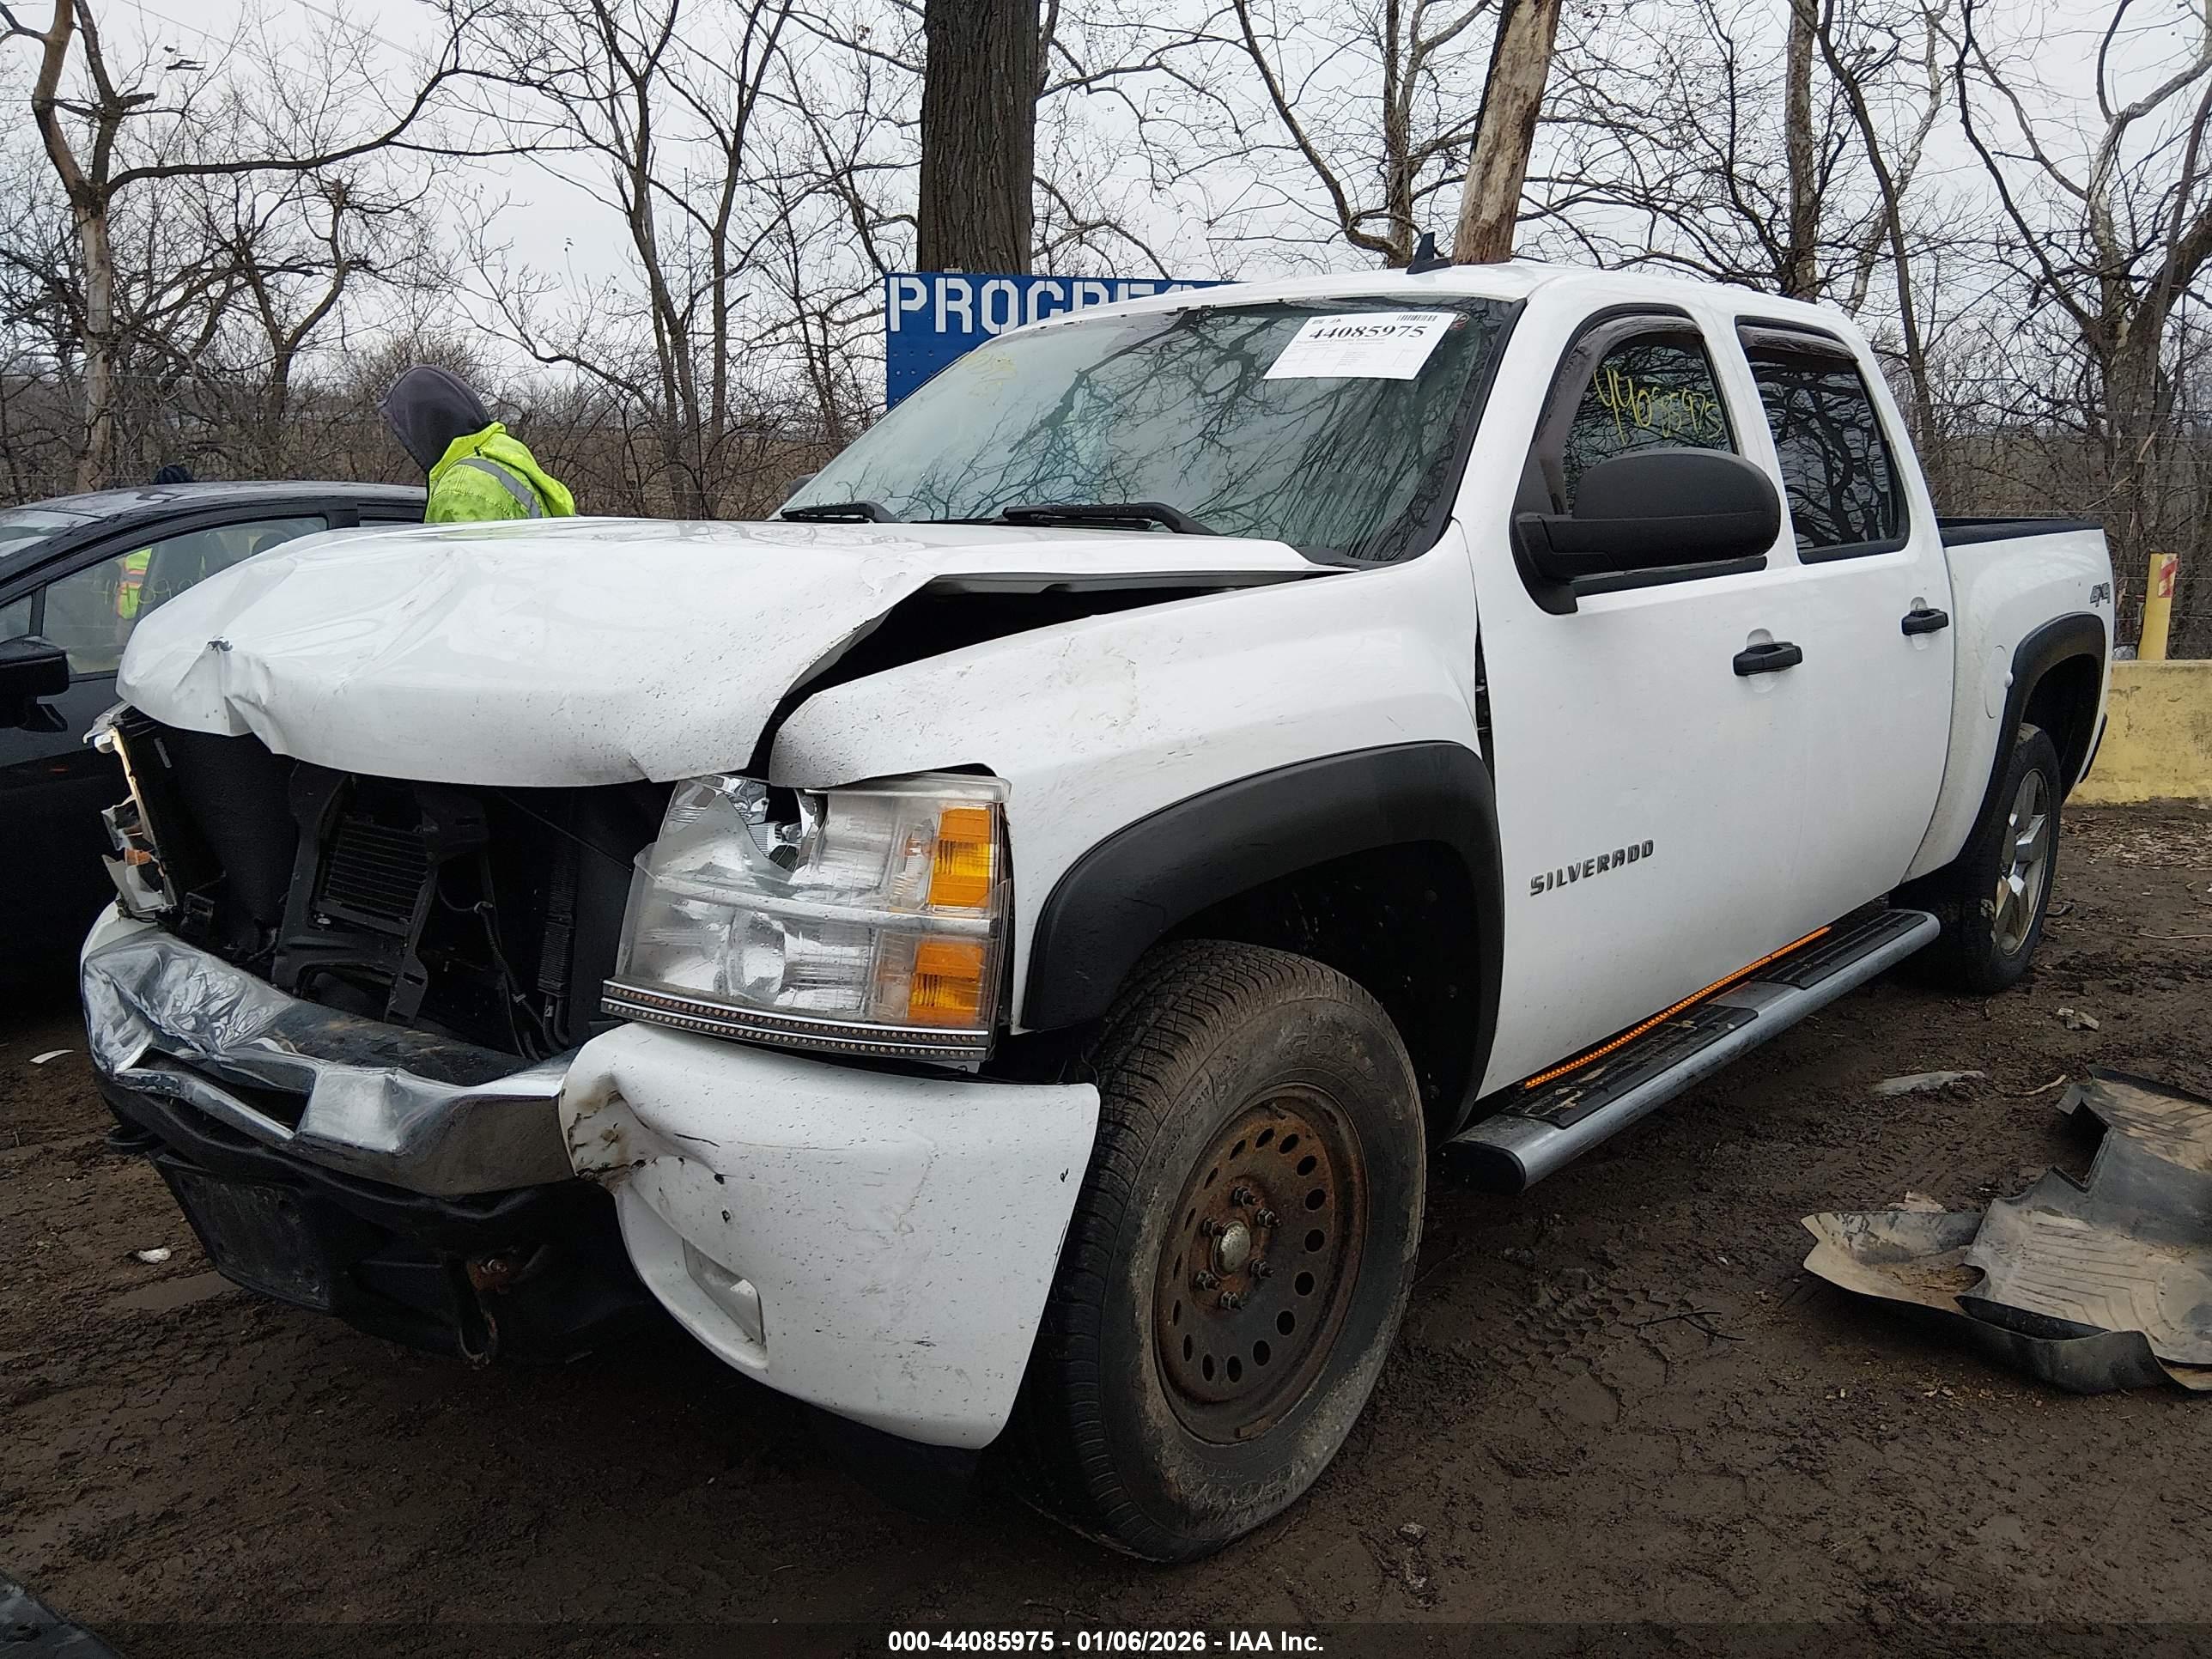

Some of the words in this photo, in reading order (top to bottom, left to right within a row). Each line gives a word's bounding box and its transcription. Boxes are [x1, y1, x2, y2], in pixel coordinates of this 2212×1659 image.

[890, 276, 1196, 334] PROGR
[1309, 325, 1428, 340] 44085975
[1529, 838, 1655, 896] SILVERADO
